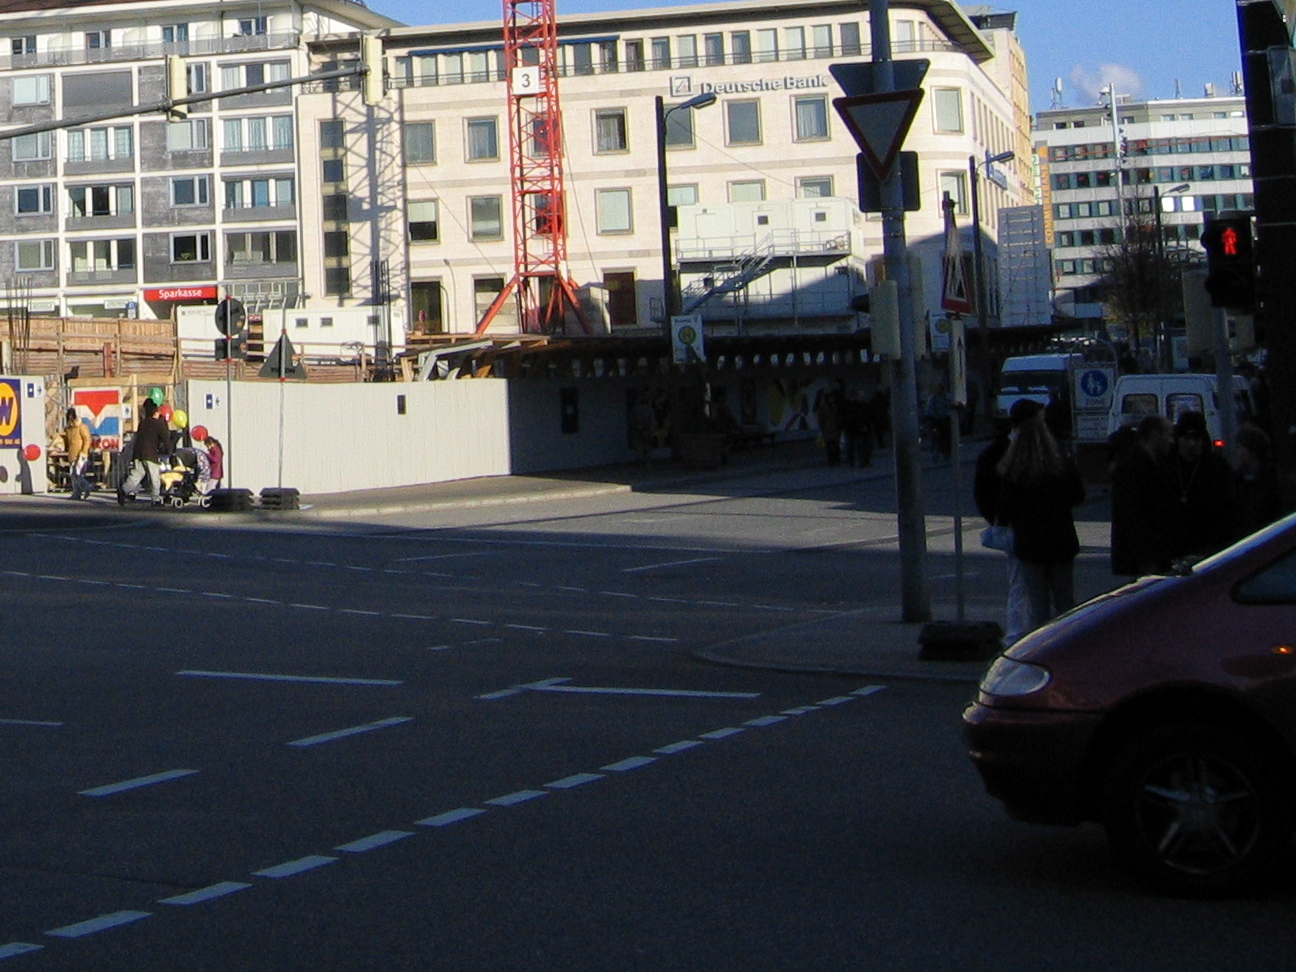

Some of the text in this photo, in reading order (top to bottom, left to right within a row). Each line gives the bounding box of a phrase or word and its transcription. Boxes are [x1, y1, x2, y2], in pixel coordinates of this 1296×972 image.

[521, 73, 530, 88] 3
[700, 74, 828, 95] Deutsche Bank
[158, 288, 203, 300] Sparkasse
